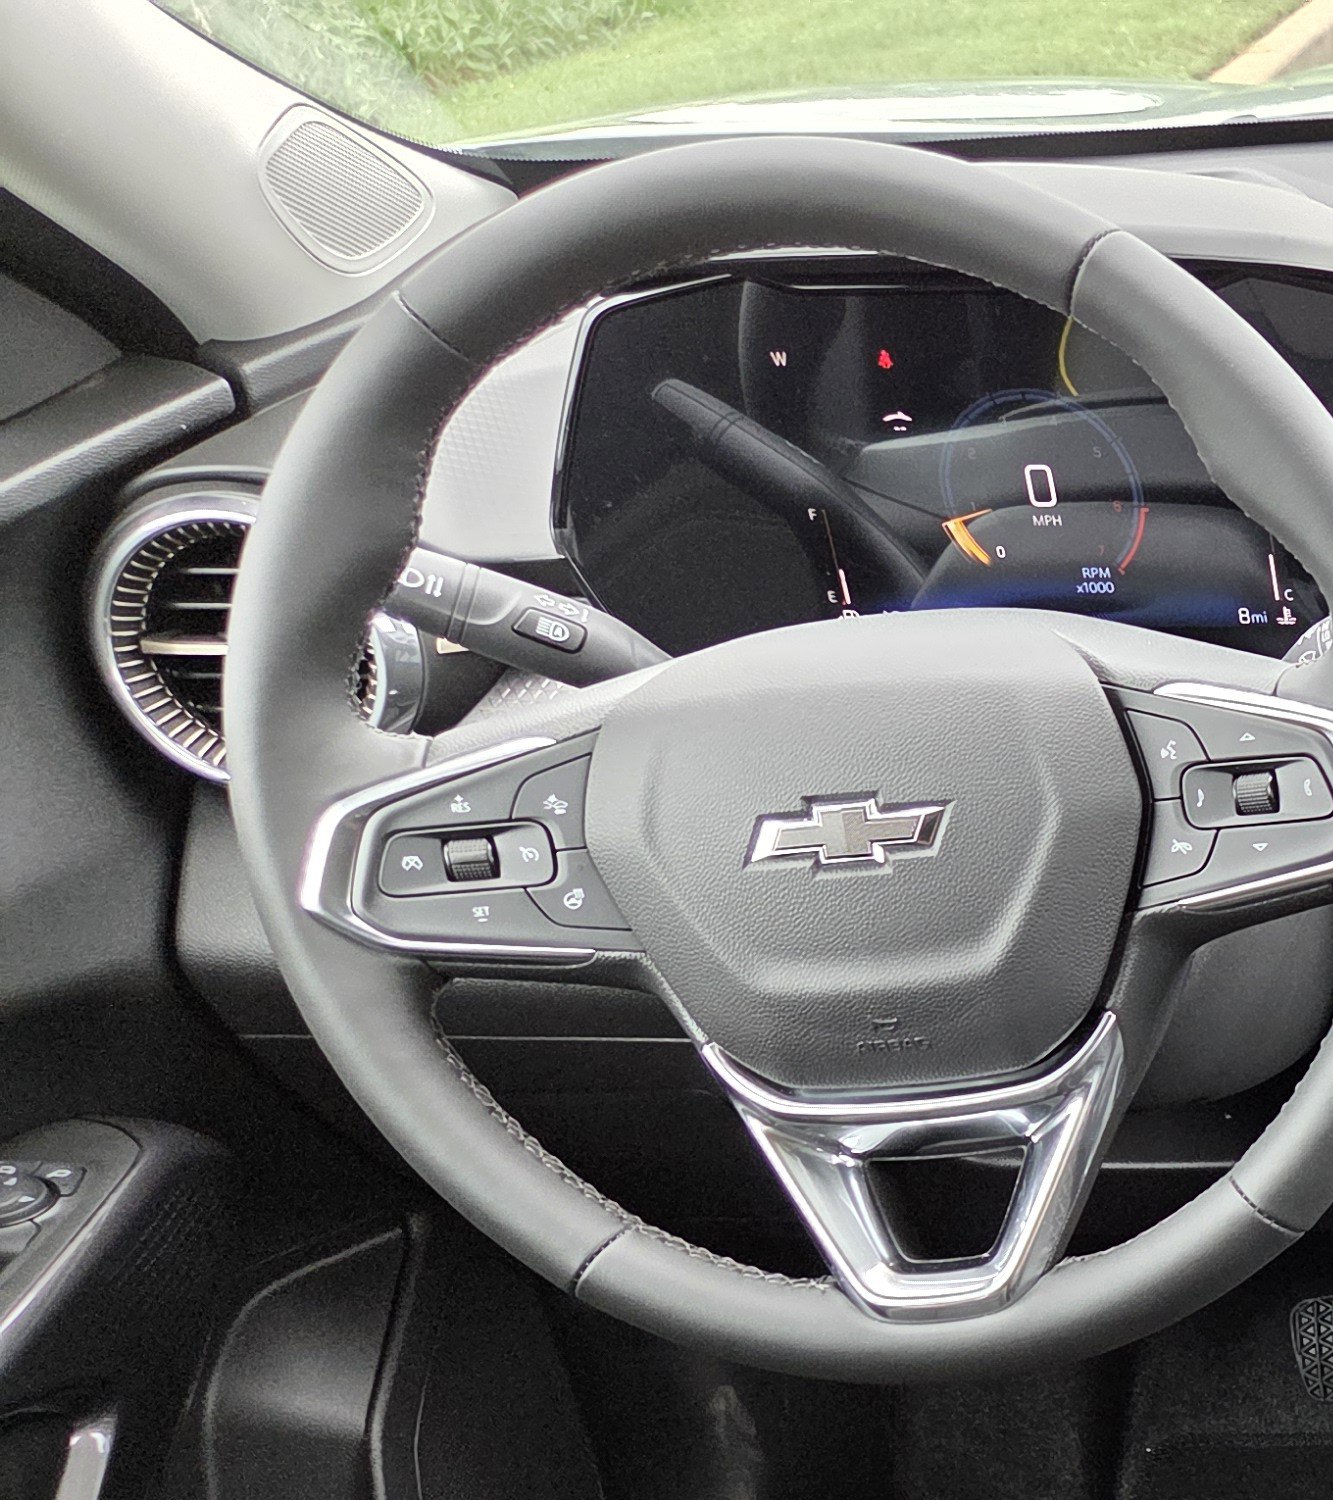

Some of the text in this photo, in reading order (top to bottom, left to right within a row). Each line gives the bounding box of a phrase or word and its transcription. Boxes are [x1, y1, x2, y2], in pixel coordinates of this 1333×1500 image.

[770, 351, 787, 367] W
[1024, 464, 1058, 508] 0
[807, 508, 817, 521] F
[1032, 514, 1063, 528] MPH
[995, 545, 1006, 559] 0
[1082, 567, 1111, 579] RPM
[1076, 581, 1115, 594] x1000
[827, 590, 838, 603] E
[1284, 589, 1294, 602] C
[451, 802, 471, 813] RES
[472, 906, 490, 918] SET
